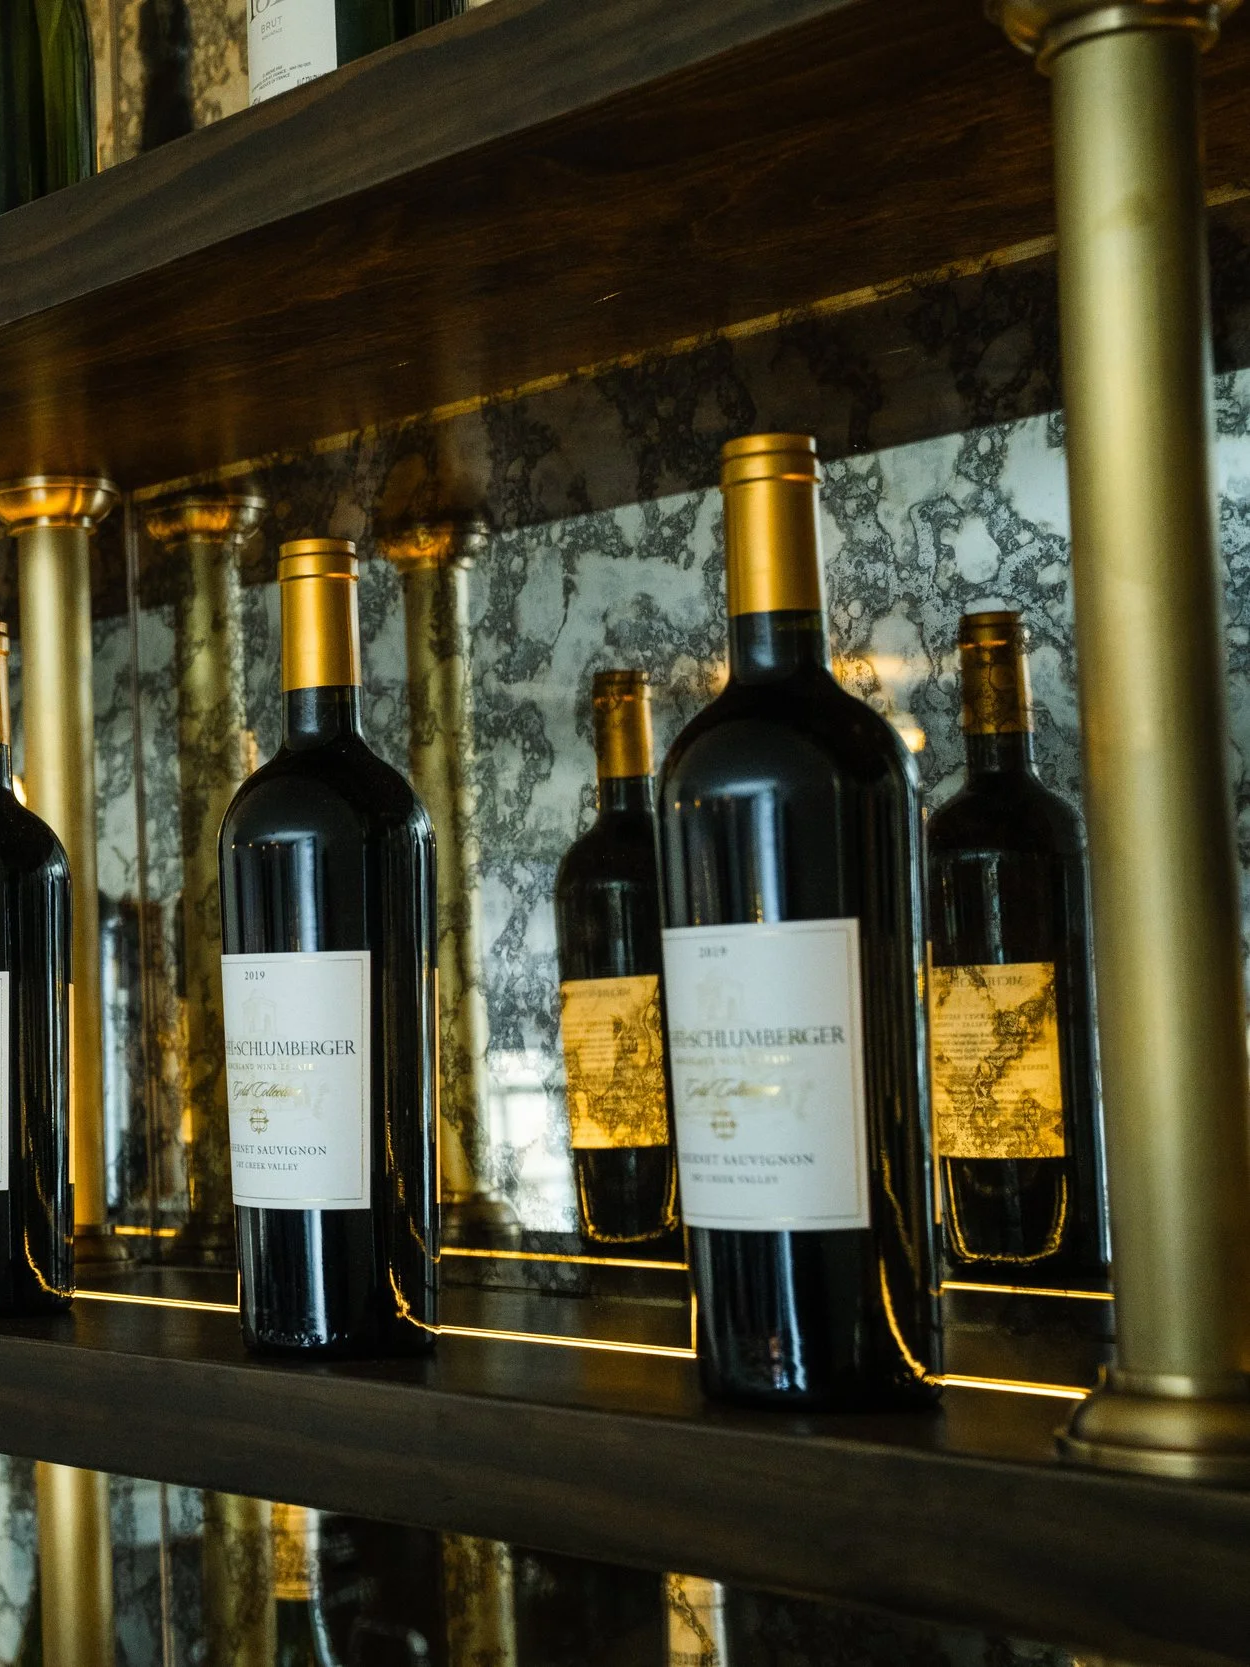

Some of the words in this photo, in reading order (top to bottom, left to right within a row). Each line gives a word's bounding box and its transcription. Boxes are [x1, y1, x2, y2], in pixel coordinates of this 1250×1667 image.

[261, 15, 283, 34] BRUT
[244, 970, 266, 981] 2019
[257, 1145, 327, 1156] SAUVIGNON
[245, 1161, 266, 1170] CREEK
[267, 1162, 299, 1171] VALLEY
